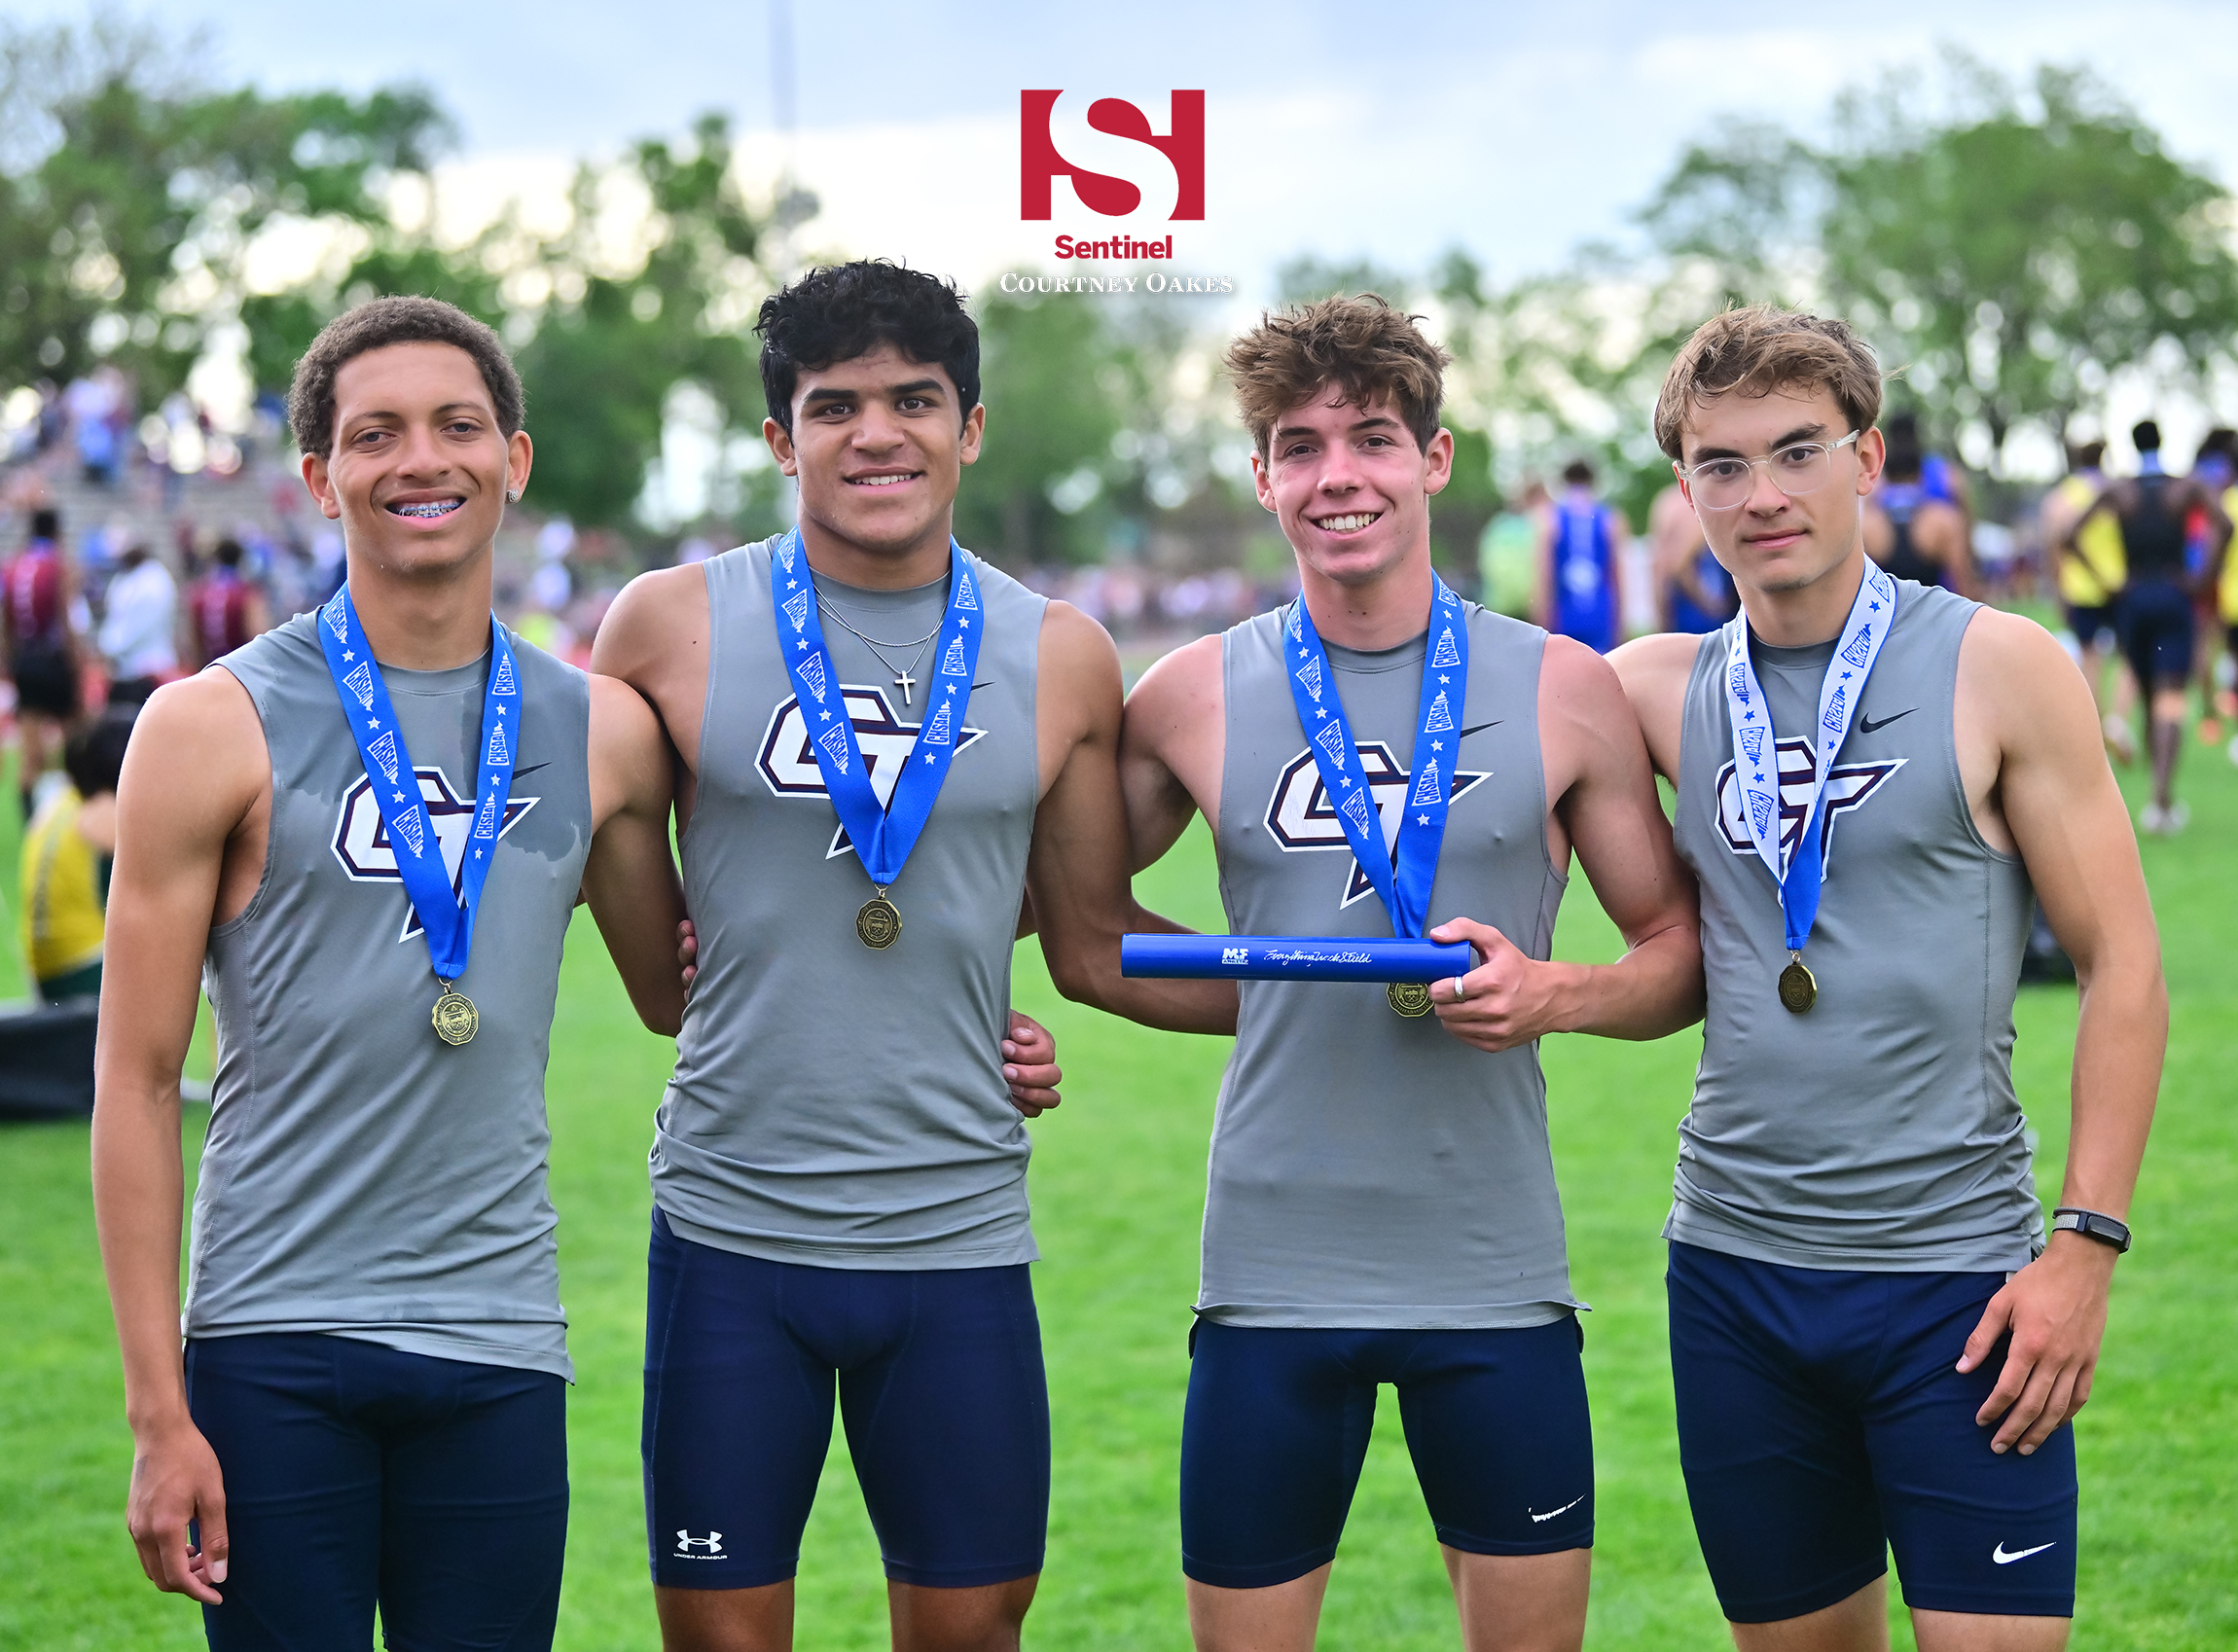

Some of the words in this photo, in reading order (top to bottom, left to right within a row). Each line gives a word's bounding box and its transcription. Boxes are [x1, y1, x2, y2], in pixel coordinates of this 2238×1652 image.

[798, 654, 825, 694] CHSAA
[943, 647, 966, 674] CHSAA
[345, 664, 373, 702] CHSAA
[493, 664, 515, 694] CHSAA
[925, 712, 950, 742] CHSAA
[1426, 702, 1451, 732] CHSAA
[370, 733, 398, 775] CHSAA
[488, 734, 509, 764] CHSAA
[821, 725, 848, 766] CHSAA
[1317, 722, 1344, 761] CHSAA
[1414, 772, 1440, 805] CHSAA
[475, 806, 495, 838] CHSAA
[1343, 790, 1369, 830] CHSAA
[394, 808, 423, 848] CHSAA
